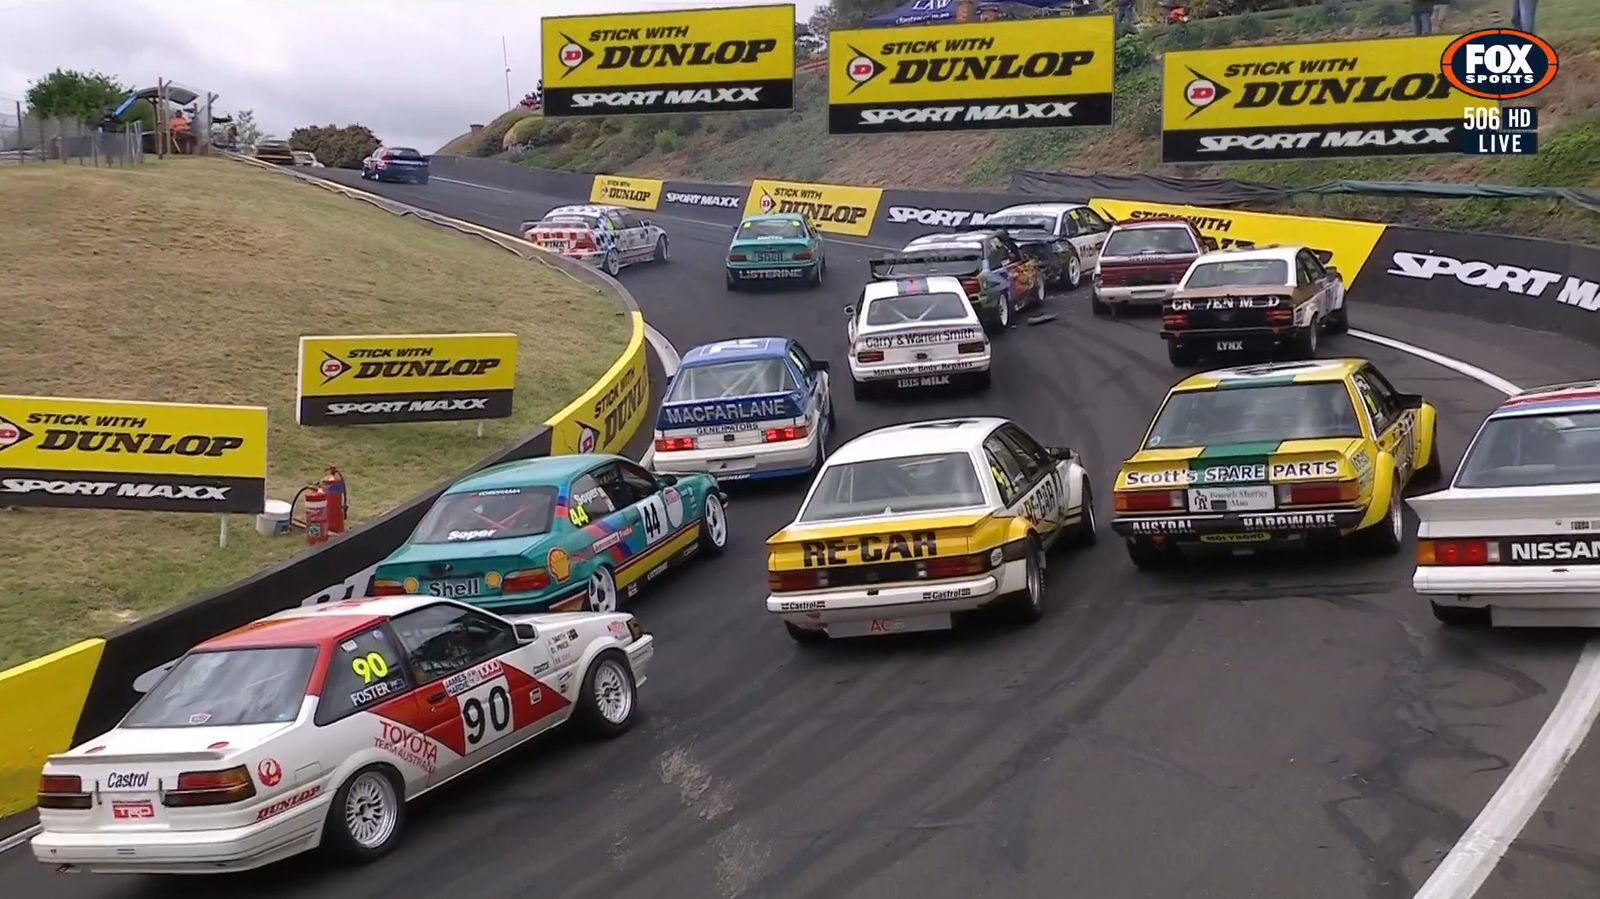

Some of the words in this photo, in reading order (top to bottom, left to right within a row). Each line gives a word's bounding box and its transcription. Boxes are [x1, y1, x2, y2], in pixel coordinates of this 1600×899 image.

[589, 28, 640, 42] STICK
[645, 26, 689, 40] WITH
[597, 39, 776, 69] DUNLOP
[880, 40, 940, 55] STICK
[944, 37, 995, 53] WITH
[889, 51, 1094, 85] DUNLOP
[1224, 60, 1296, 78] STICK
[1300, 57, 1359, 74] WITH
[570, 90, 665, 108] SPORT
[664, 86, 763, 105] MAXX
[858, 107, 965, 125] SPORT
[964, 102, 1078, 122] MAXX
[1197, 132, 1319, 153] SPORT
[1321, 126, 1456, 148] MAXX
[609, 187, 651, 202] DUNLOP
[666, 192, 702, 203] SPORT
[701, 194, 740, 207] MAXX
[774, 187, 798, 197] STICK
[800, 189, 823, 199] WITH
[779, 200, 868, 224] DUNLOP
[888, 206, 970, 227] SPORT
[739, 268, 802, 279] LISTERINE
[1387, 252, 1563, 297] SPORT
[1172, 298, 1234, 310] CREN
[1240, 295, 1280, 308] MD
[896, 334, 904, 345] &
[904, 331, 943, 344] Warren
[943, 328, 975, 340] Smith
[1217, 341, 1243, 351] LYNX
[347, 349, 393, 359] STICK
[396, 347, 434, 357] WITH
[353, 358, 501, 379] DUNLOP
[921, 375, 951, 386] MILK
[325, 401, 406, 416] SPORT
[408, 397, 489, 413] MAXX
[594, 383, 619, 419] STICK
[666, 399, 786, 424] MACFARLANE
[27, 412, 91, 426] STICK
[96, 415, 147, 428] WITH
[696, 422, 760, 434] GENERATORS
[37, 428, 244, 457] DUNLOP
[1126, 469, 1198, 486] Scott's
[1205, 464, 1265, 482] SPARE
[1272, 460, 1338, 478] PARTS
[0, 478, 116, 496] SPORT
[116, 482, 232, 500] MAXX
[573, 487, 602, 506] Soper
[569, 505, 590, 527] 44
[643, 502, 662, 538] 44
[448, 529, 497, 541] Soper
[803, 531, 938, 568] RE-CAR
[429, 577, 480, 598] Shell
[932, 590, 962, 600] Castrol
[789, 601, 818, 610] Castrol
[352, 652, 389, 684] 90
[446, 674, 467, 688] JAMES
[350, 682, 391, 707] FOSTER
[463, 685, 511, 745] 90
[374, 736, 398, 757] TEAM
[379, 720, 438, 764] TOYOTA
[107, 771, 149, 789] Castrol
[116, 804, 152, 818] TRD
[256, 785, 321, 821] DUNLOP
